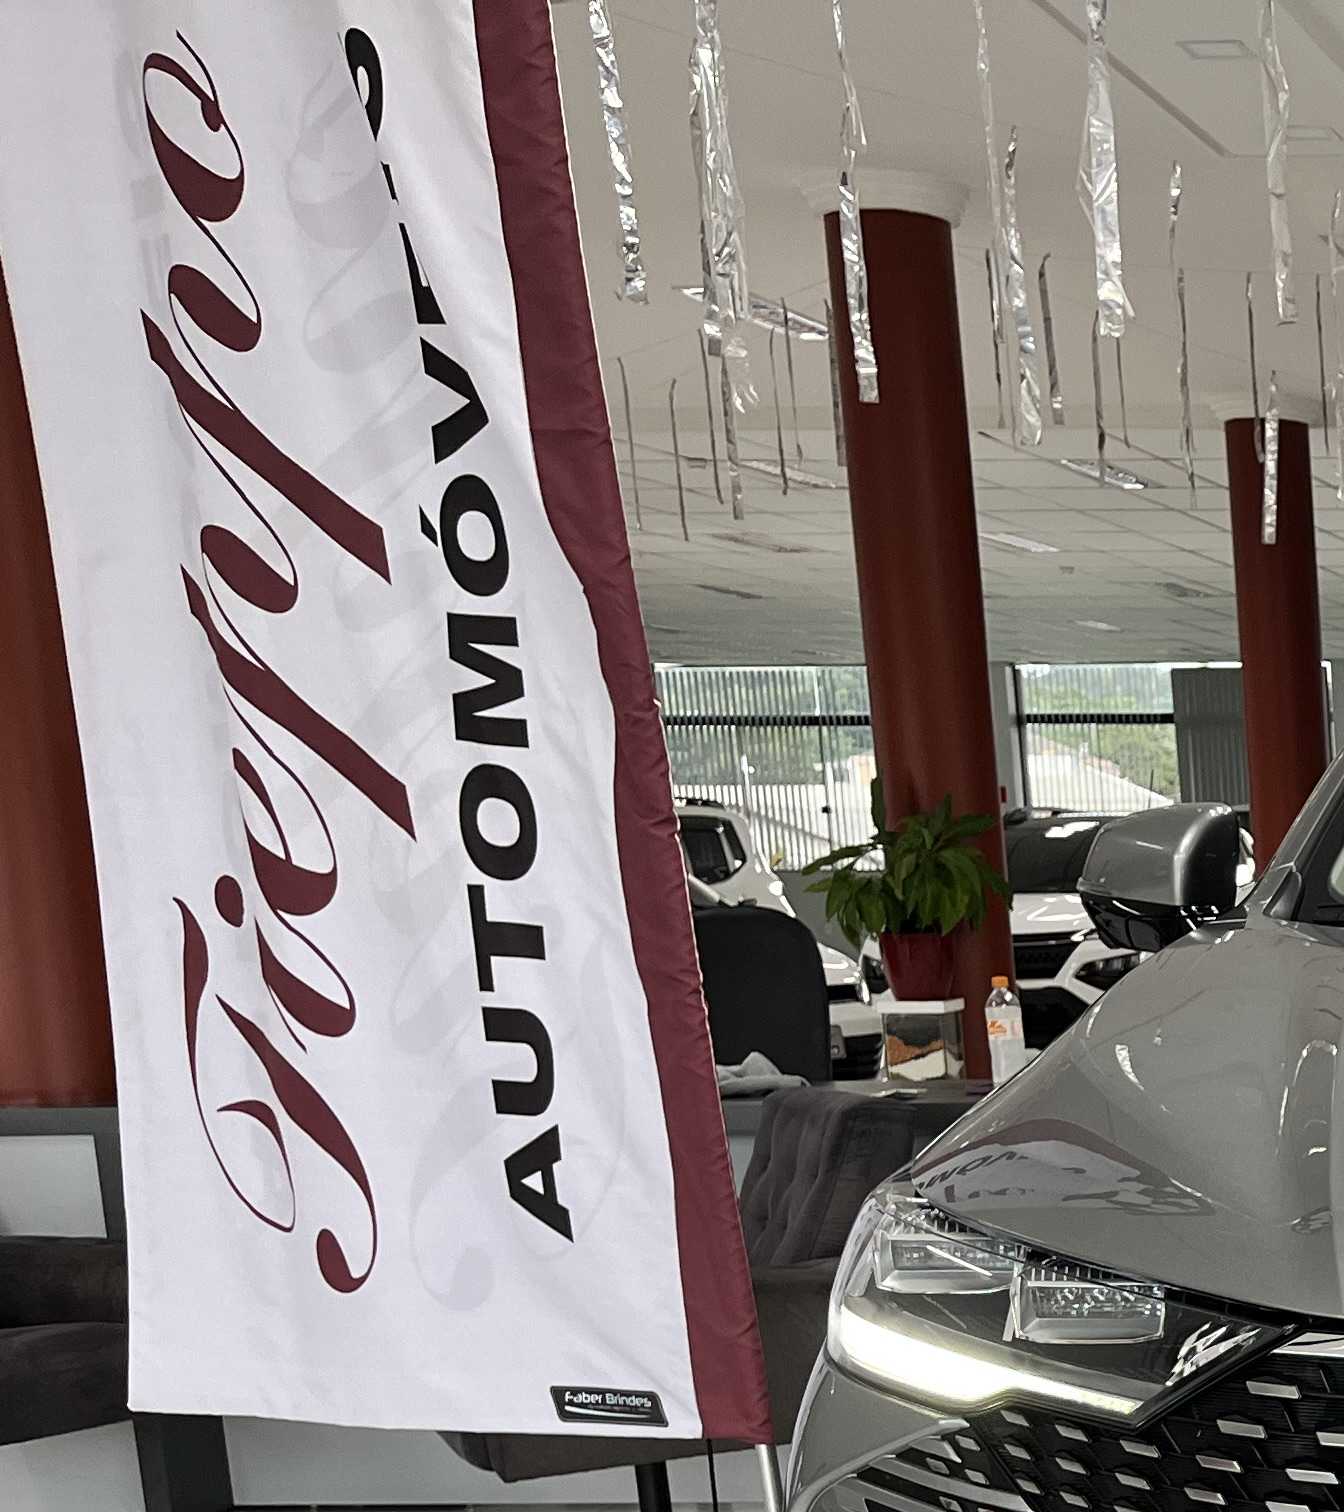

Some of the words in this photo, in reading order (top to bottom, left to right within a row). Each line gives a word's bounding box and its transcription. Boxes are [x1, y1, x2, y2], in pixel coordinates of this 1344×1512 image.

[141, 29, 416, 1294] Tieppo
[340, 27, 573, 1242] AUTOMÓVS
[564, 1391, 602, 1404] Faber
[605, 1393, 652, 1407] Brindes
